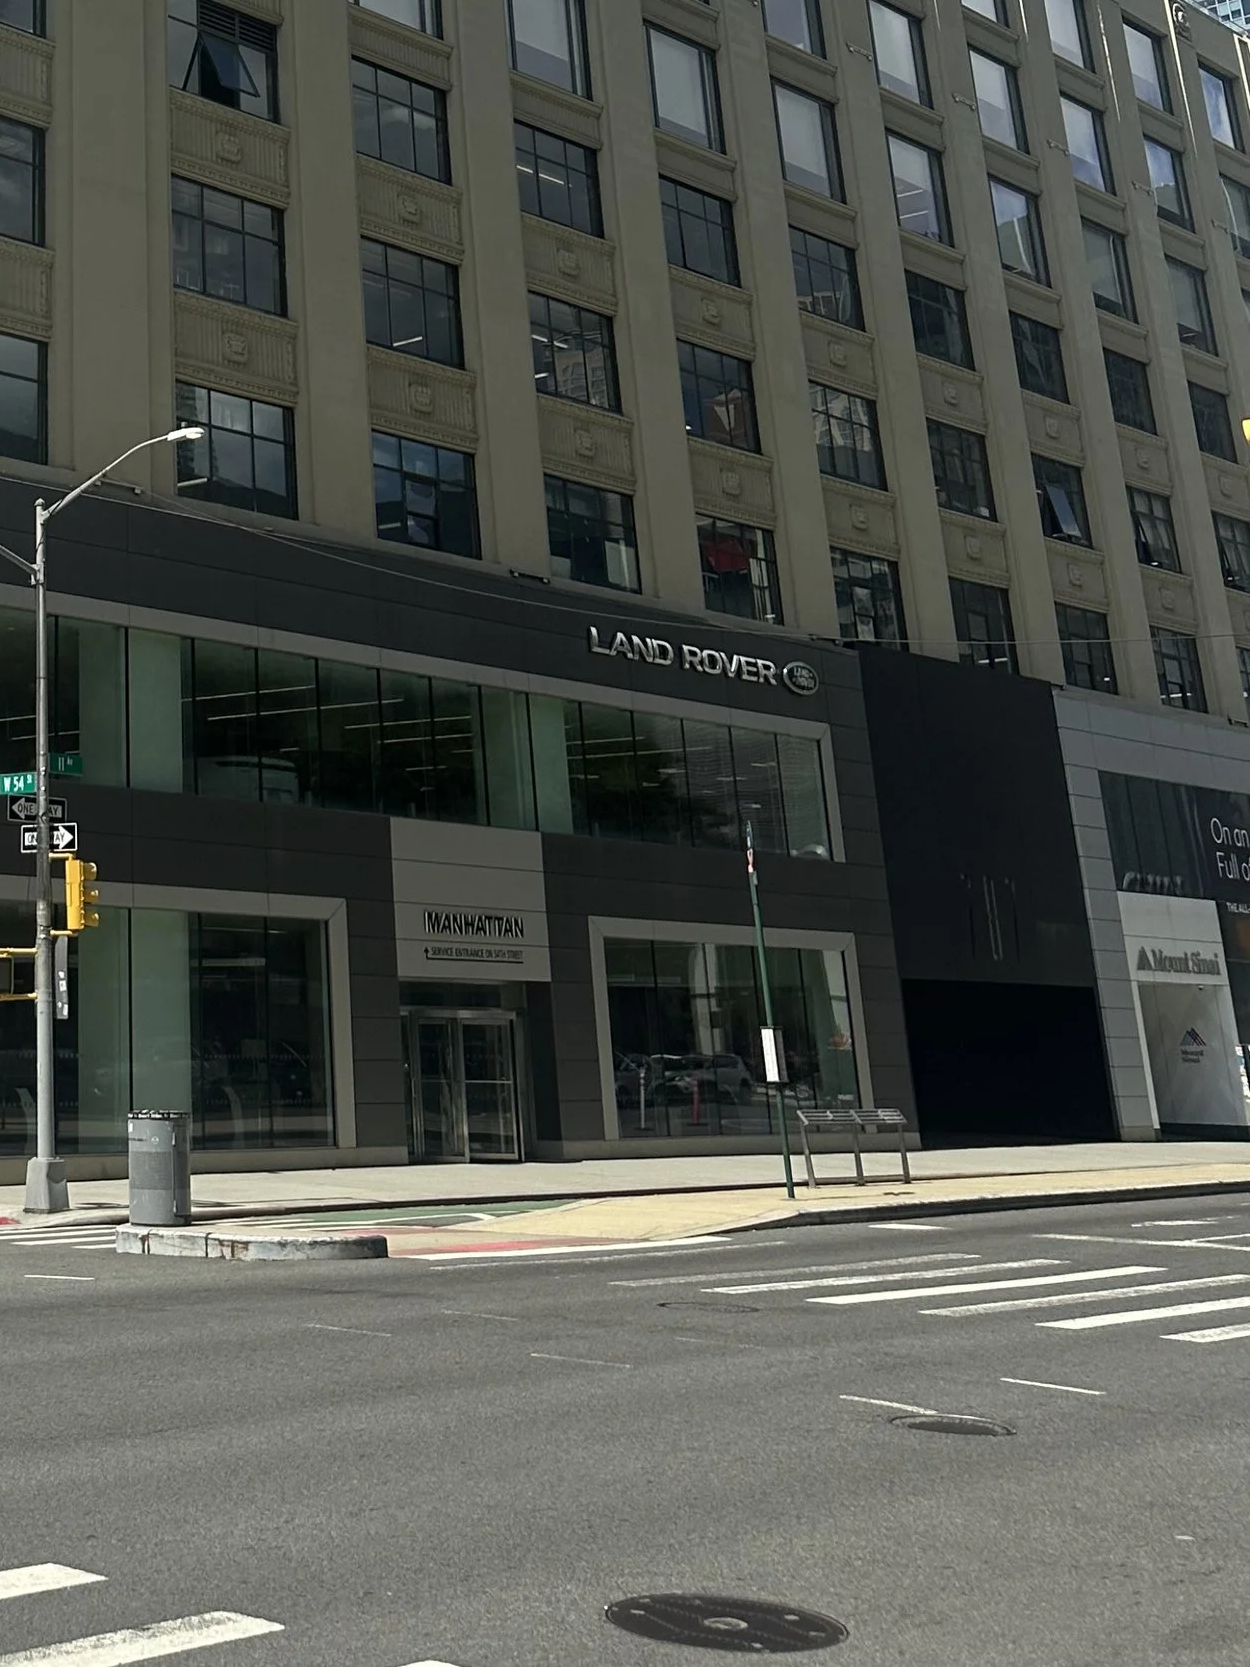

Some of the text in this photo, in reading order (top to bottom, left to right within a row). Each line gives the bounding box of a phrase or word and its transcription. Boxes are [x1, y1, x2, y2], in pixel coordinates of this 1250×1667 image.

[589, 626, 778, 686] LAND ROVER
[3, 776, 12, 793] W
[13, 775, 25, 792] 54
[17, 802, 34, 814] ONE
[1210, 817, 1232, 845] On
[1216, 851, 1250, 882] Full o
[424, 910, 525, 939] MANHATTAN
[431, 945, 454, 957] SERVICE
[454, 946, 485, 959] ENTRANCE
[1151, 947, 1222, 976] Mount Sinai
